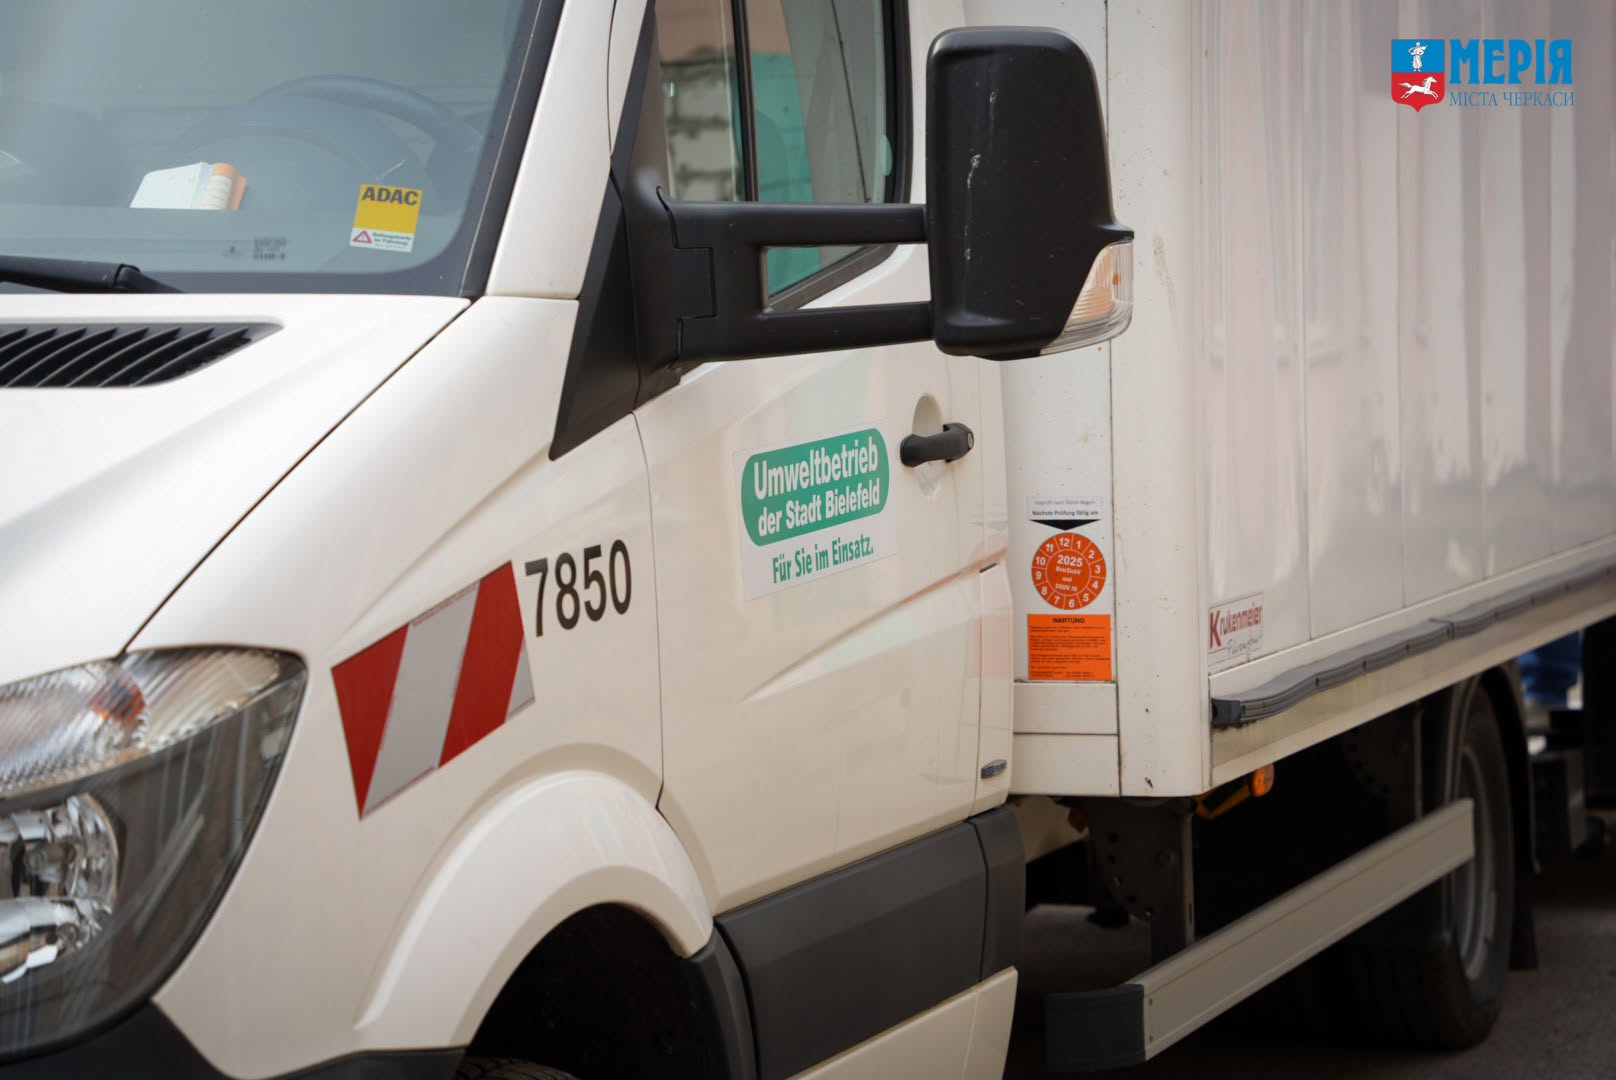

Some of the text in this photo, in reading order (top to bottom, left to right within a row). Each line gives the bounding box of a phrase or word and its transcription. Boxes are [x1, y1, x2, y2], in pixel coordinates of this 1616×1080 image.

[362, 186, 418, 206] ADAC
[754, 436, 878, 500] Umweltbetrieb
[758, 478, 880, 537] der Stadt Bielefeld
[1059, 538, 1070, 547] 12
[1076, 540, 1081, 549] 1
[1045, 544, 1054, 552] 11
[772, 533, 874, 584] Für Sie im Einsatz.
[1088, 550, 1095, 558] 2
[1035, 557, 1046, 566] 10
[1057, 554, 1083, 567] 2025
[1095, 565, 1101, 574] 3
[1036, 571, 1042, 580] 9
[524, 538, 632, 638] 7850
[1092, 581, 1099, 589] 4
[1042, 587, 1048, 595] 8
[1054, 596, 1060, 605] 7
[1083, 594, 1089, 602] 5
[1069, 599, 1075, 608] 6
